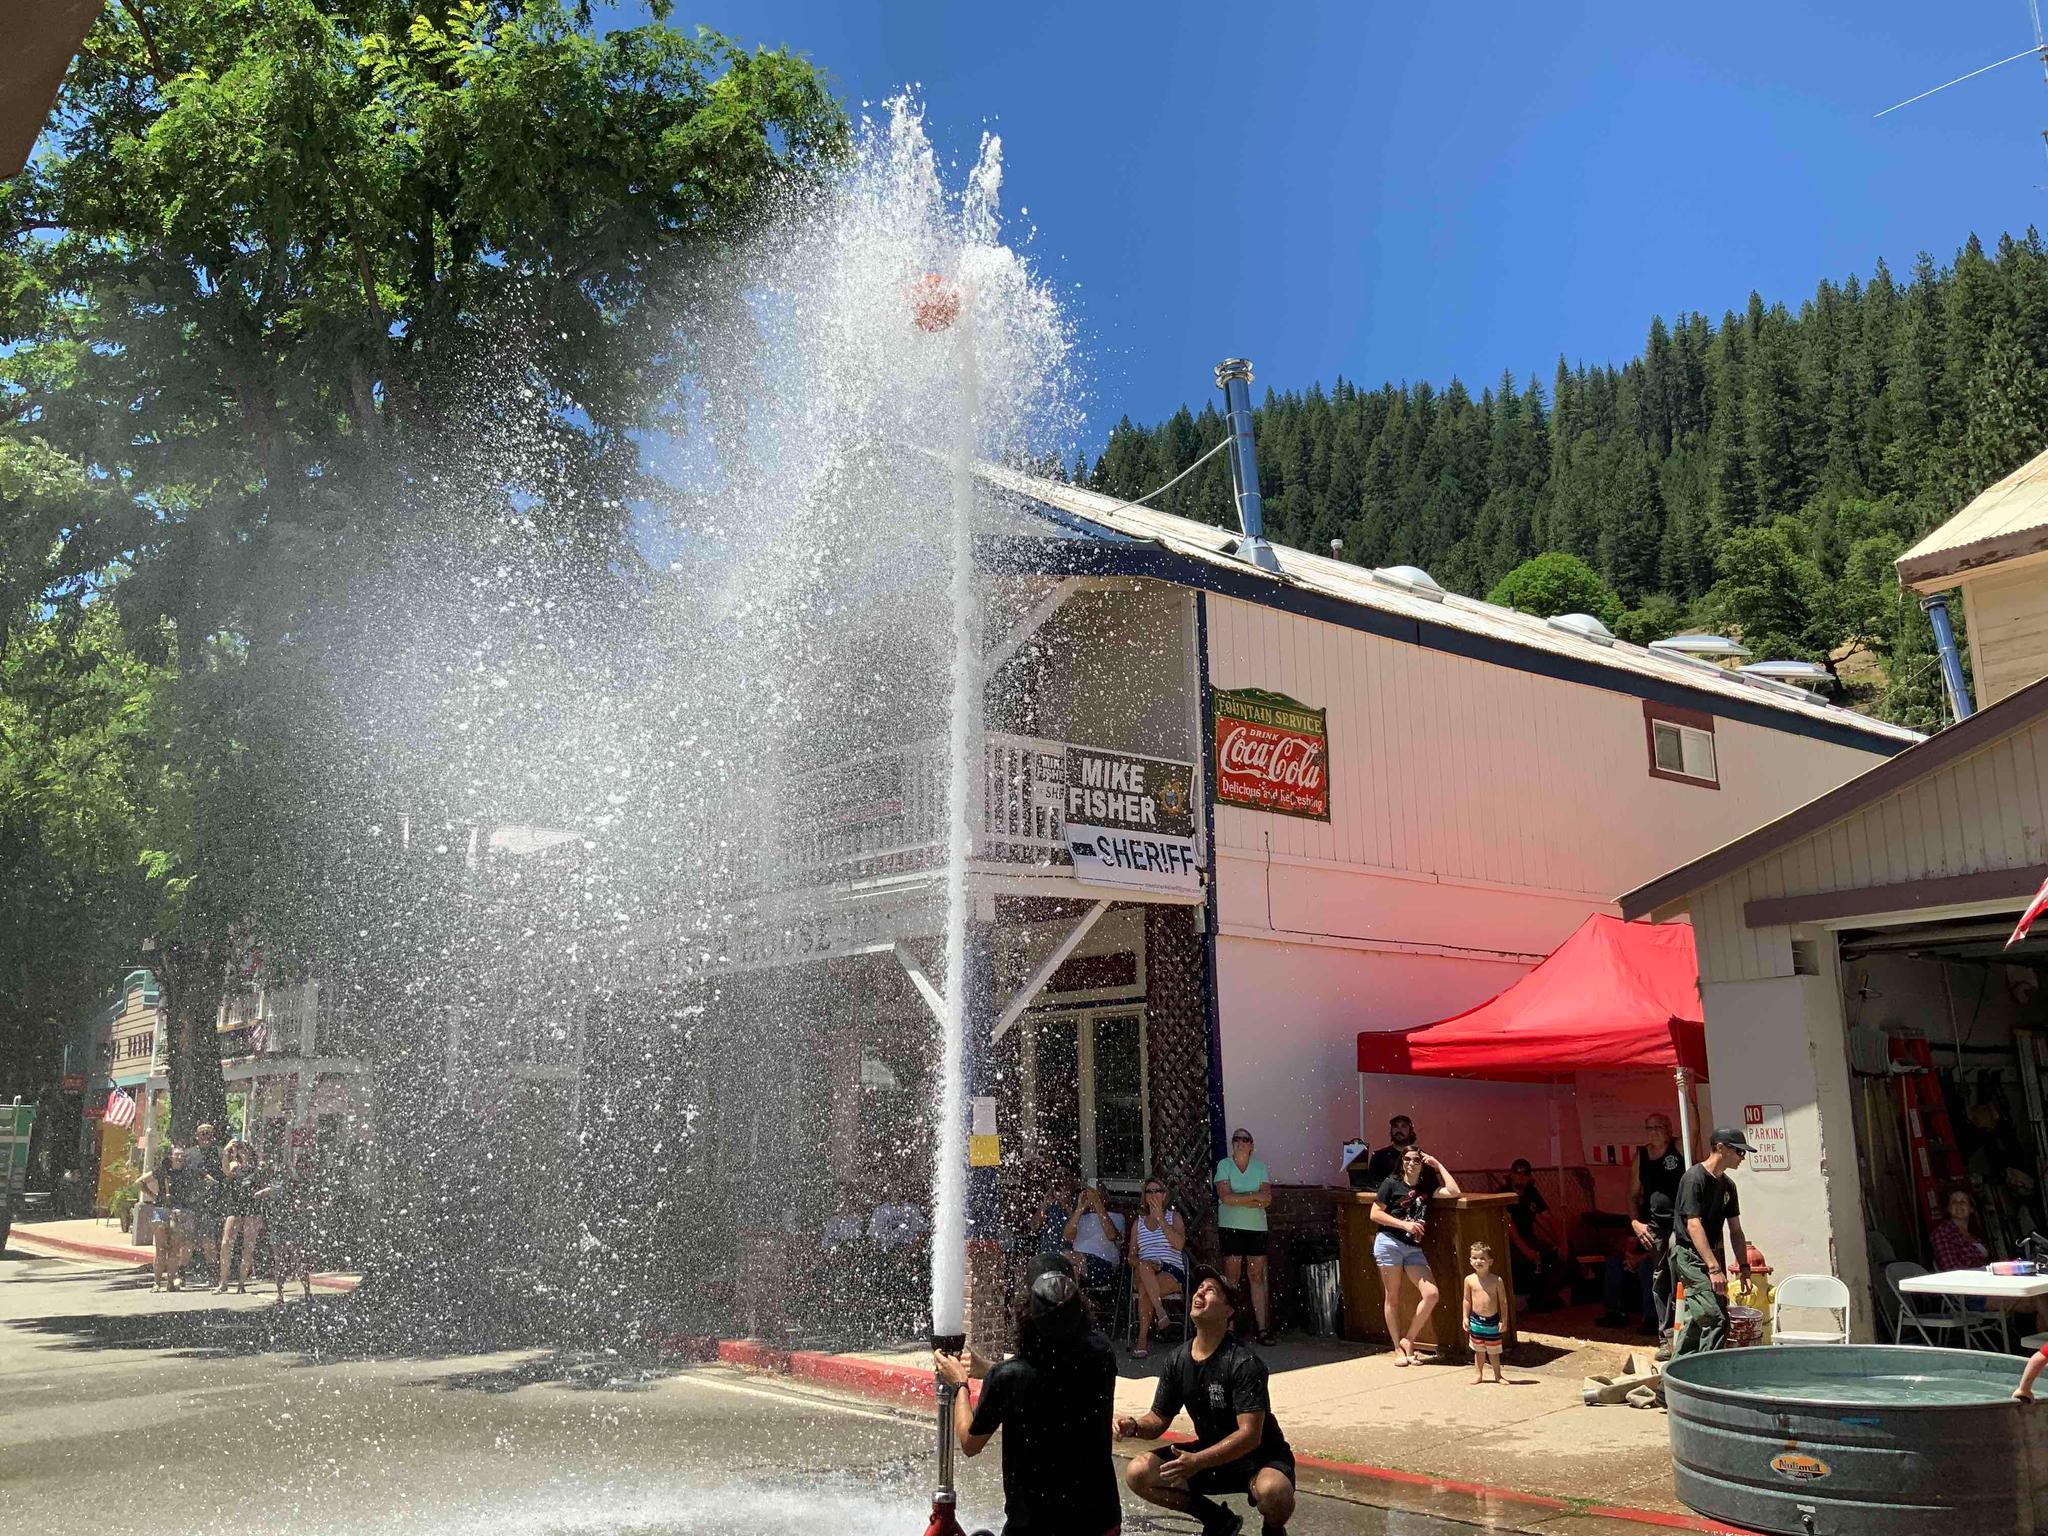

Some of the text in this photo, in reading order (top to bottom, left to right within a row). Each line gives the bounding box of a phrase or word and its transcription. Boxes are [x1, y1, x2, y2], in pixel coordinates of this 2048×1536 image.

[1219, 699, 1323, 733] FOUNTAIN SERVICE
[1249, 729, 1280, 741] DRINK
[1081, 757, 1145, 794] MIKE
[1222, 777, 1261, 798] Delicious
[1069, 785, 1157, 825] FISHER
[1097, 835, 1194, 876] SHERIFF
[1746, 1107, 1761, 1122] NO
[1749, 1127, 1784, 1140] PARKING
[1760, 1143, 1777, 1153] FIRE
[1754, 1154, 1785, 1164] STATION
